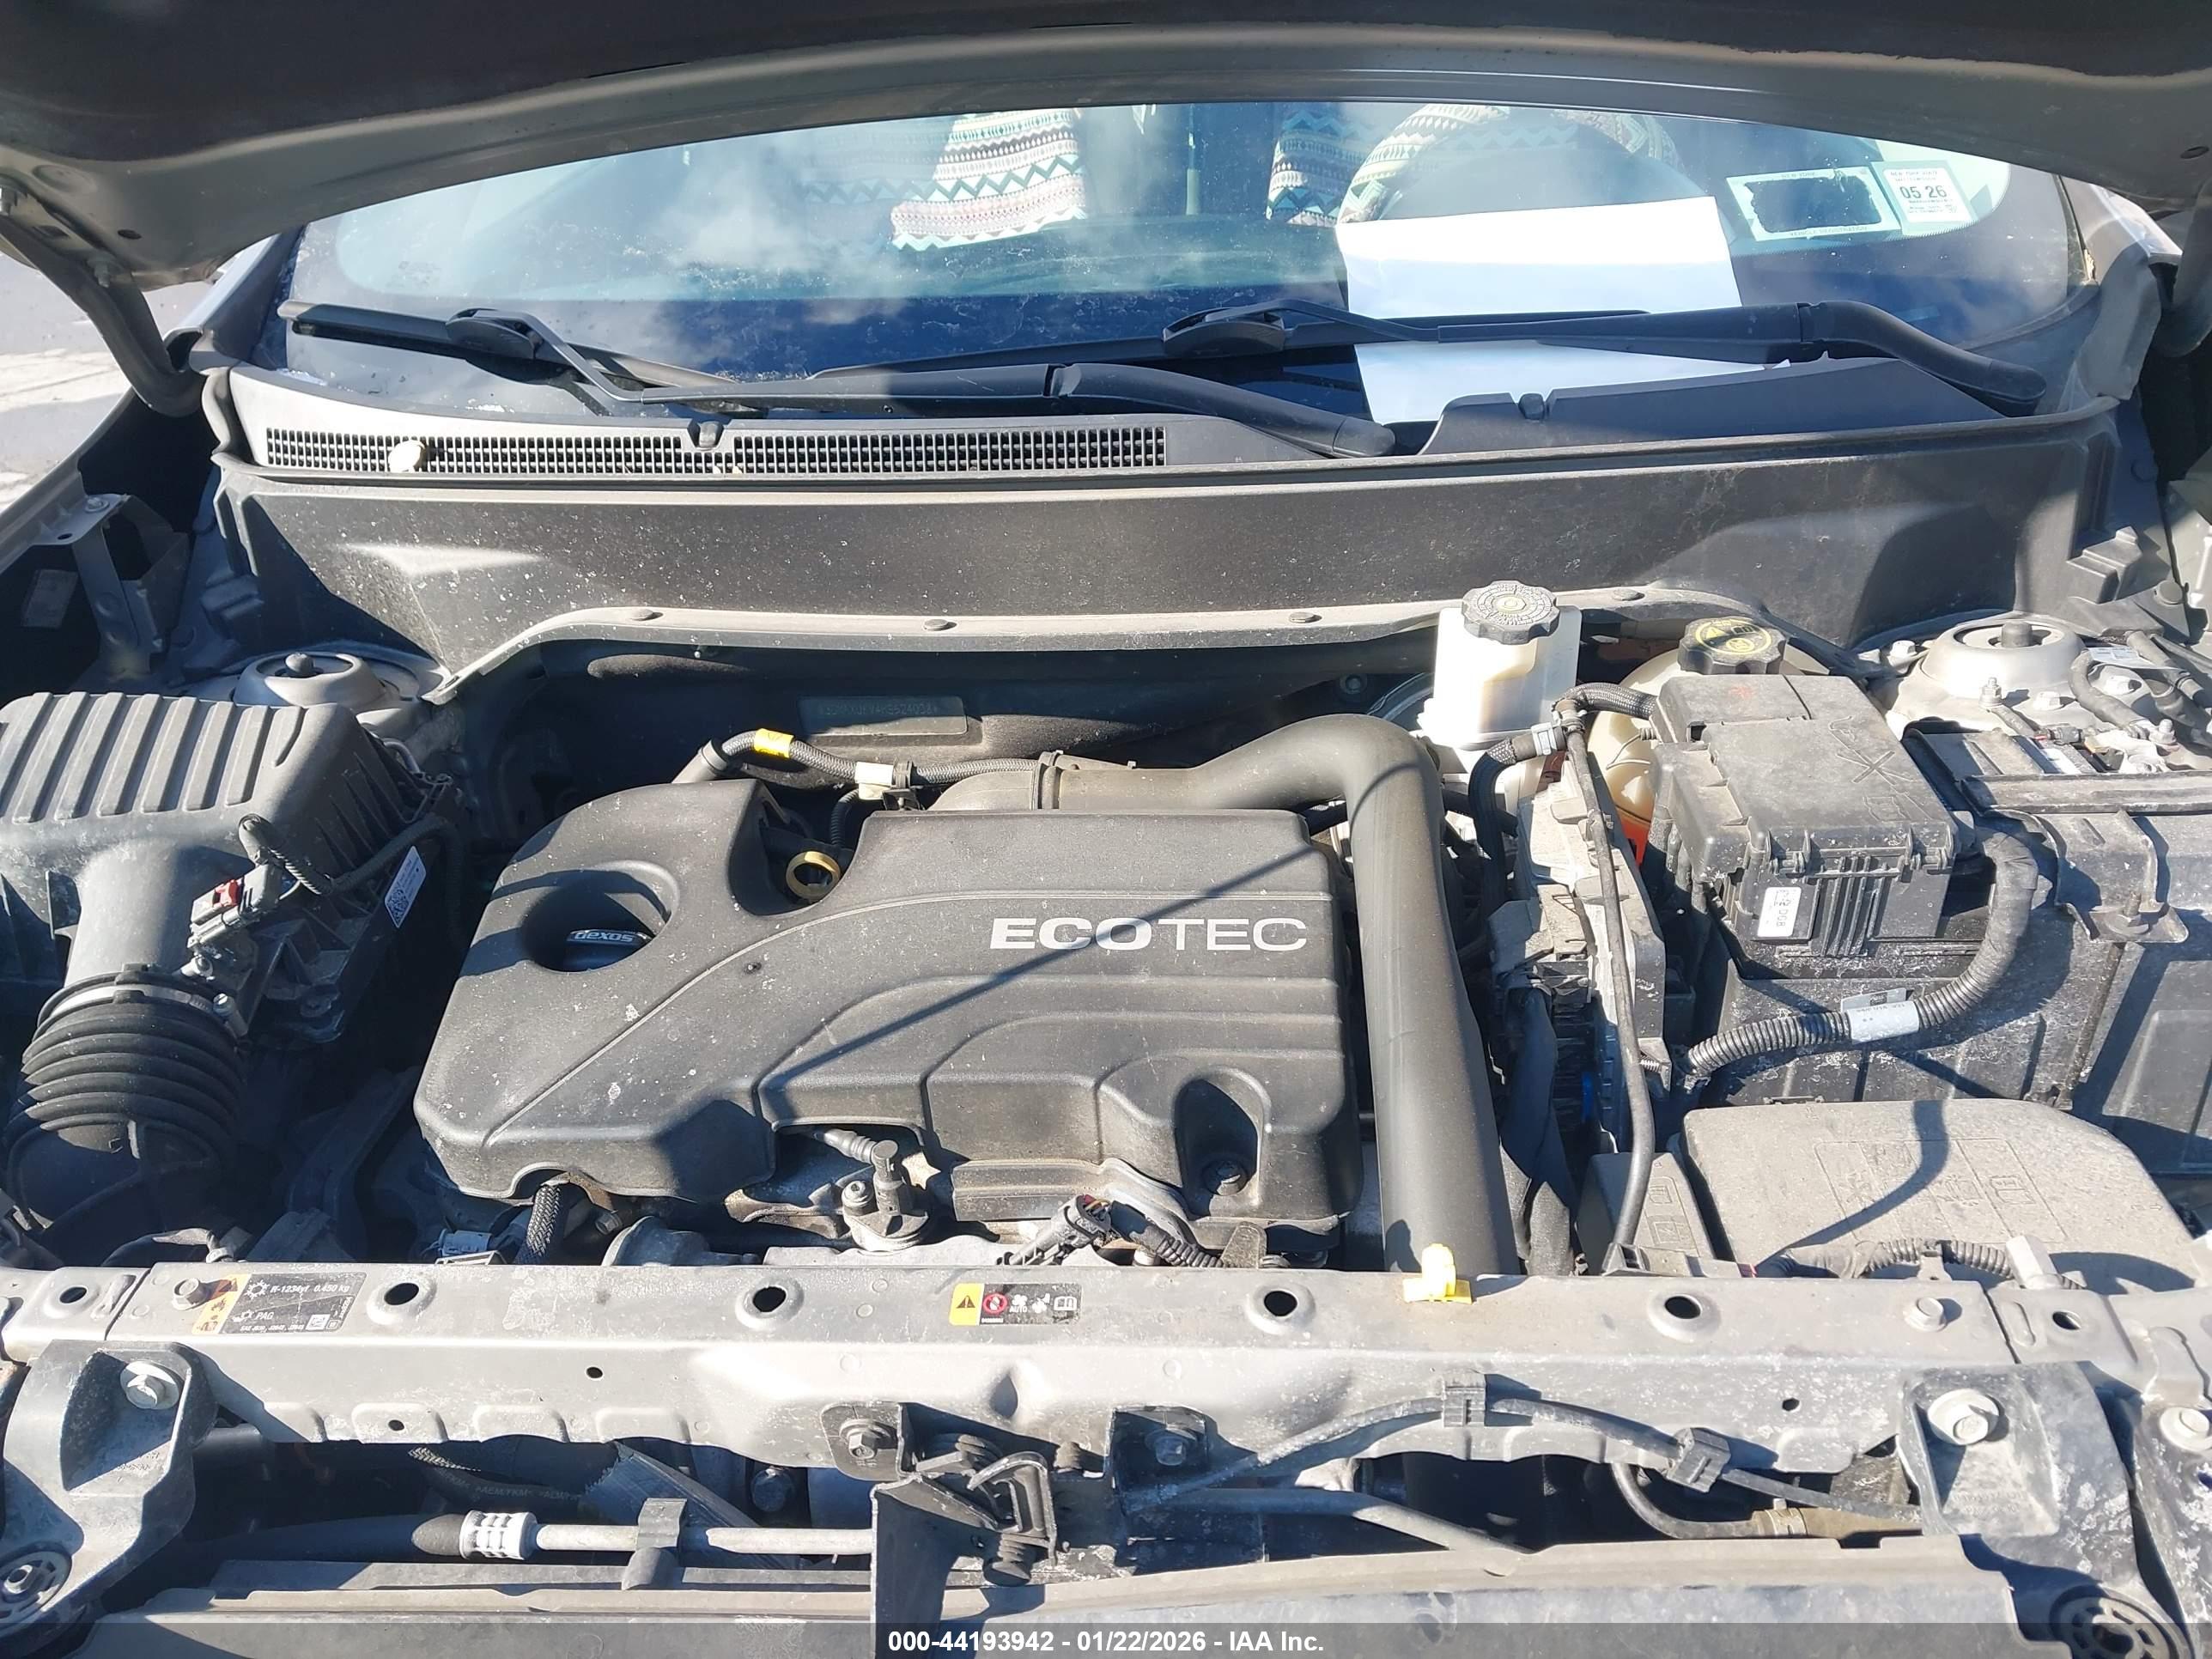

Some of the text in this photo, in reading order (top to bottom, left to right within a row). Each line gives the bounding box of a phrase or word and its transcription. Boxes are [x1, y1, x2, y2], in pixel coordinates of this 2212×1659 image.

[1899, 185, 1948, 198] 05 26
[574, 931, 635, 943] dexos
[989, 917, 1307, 951] ECOTEC
[254, 1311, 275, 1321] PAG
